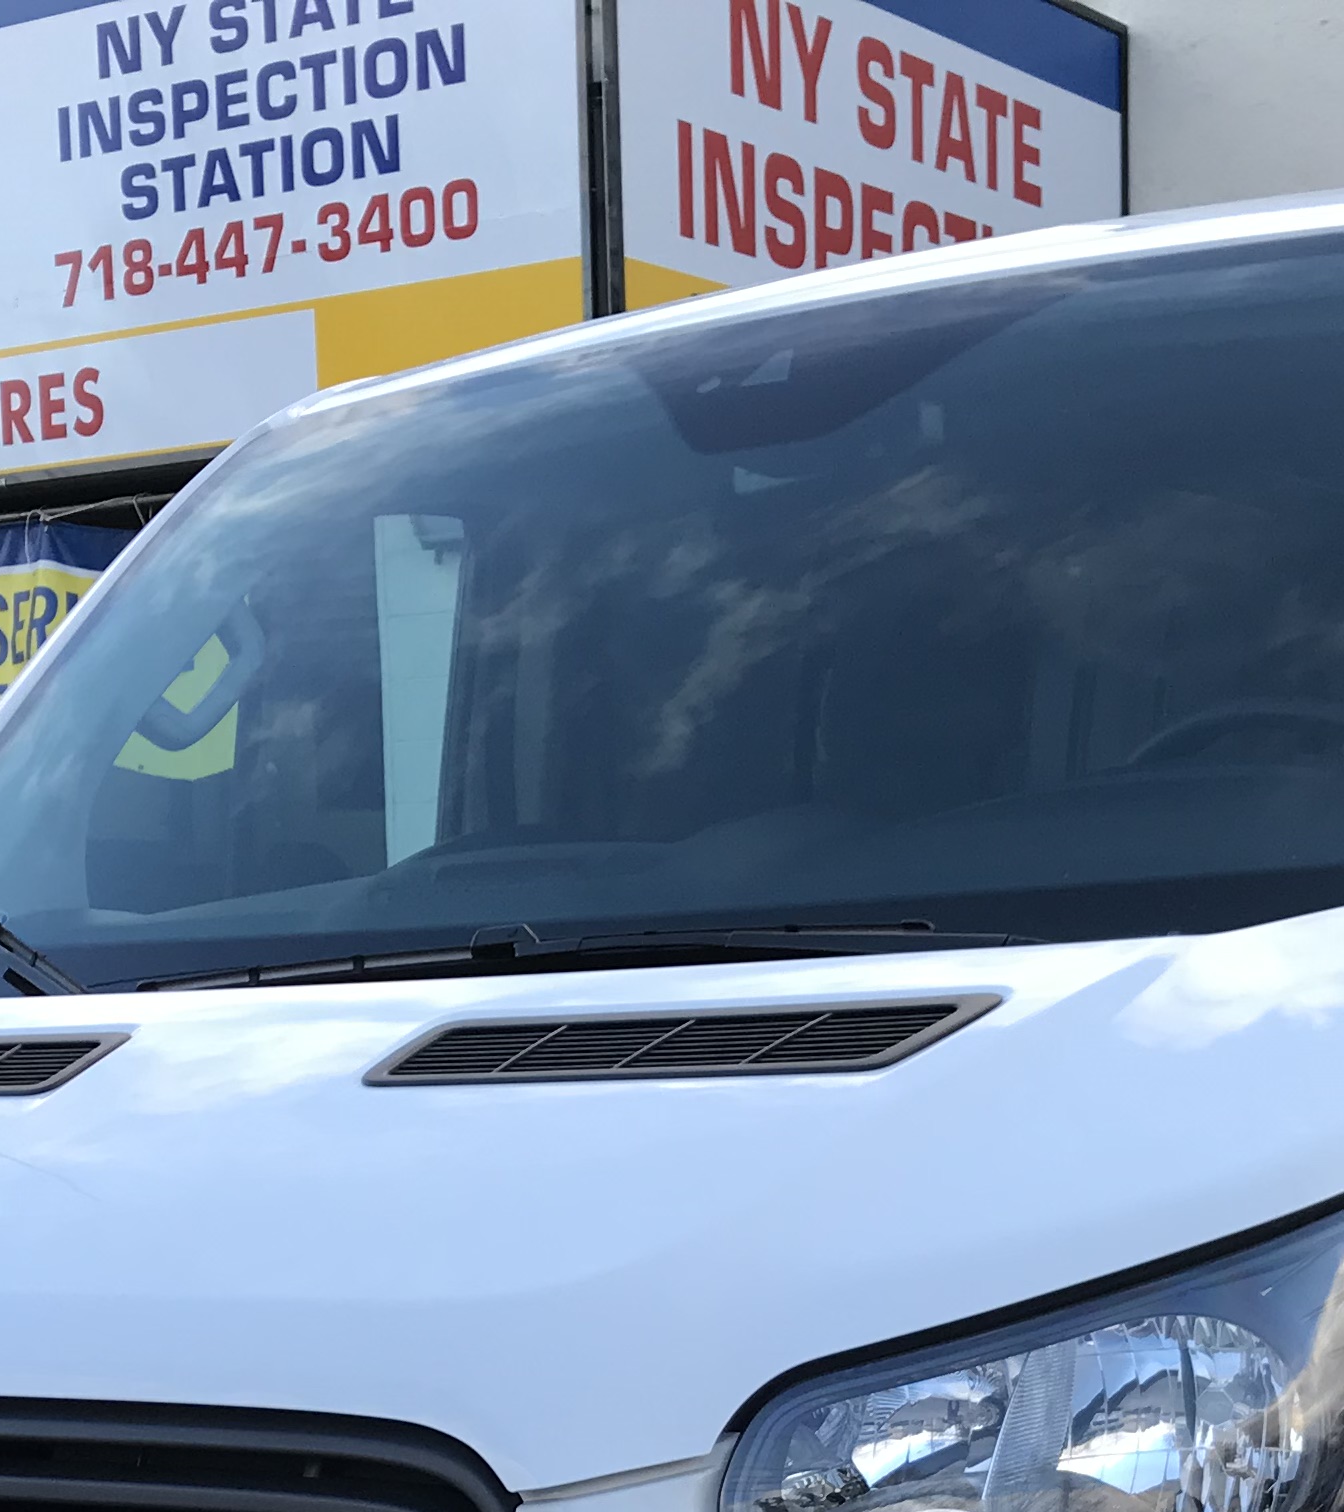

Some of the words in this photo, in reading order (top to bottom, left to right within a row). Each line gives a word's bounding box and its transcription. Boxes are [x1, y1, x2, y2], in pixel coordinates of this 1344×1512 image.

[57, 23, 467, 162] INSPECTION
[96, 0, 185, 79] NY
[730, 0, 833, 124] NY
[856, 36, 1042, 207] STATE
[120, 114, 401, 220] STATION
[55, 178, 478, 308] 718-447-3400
